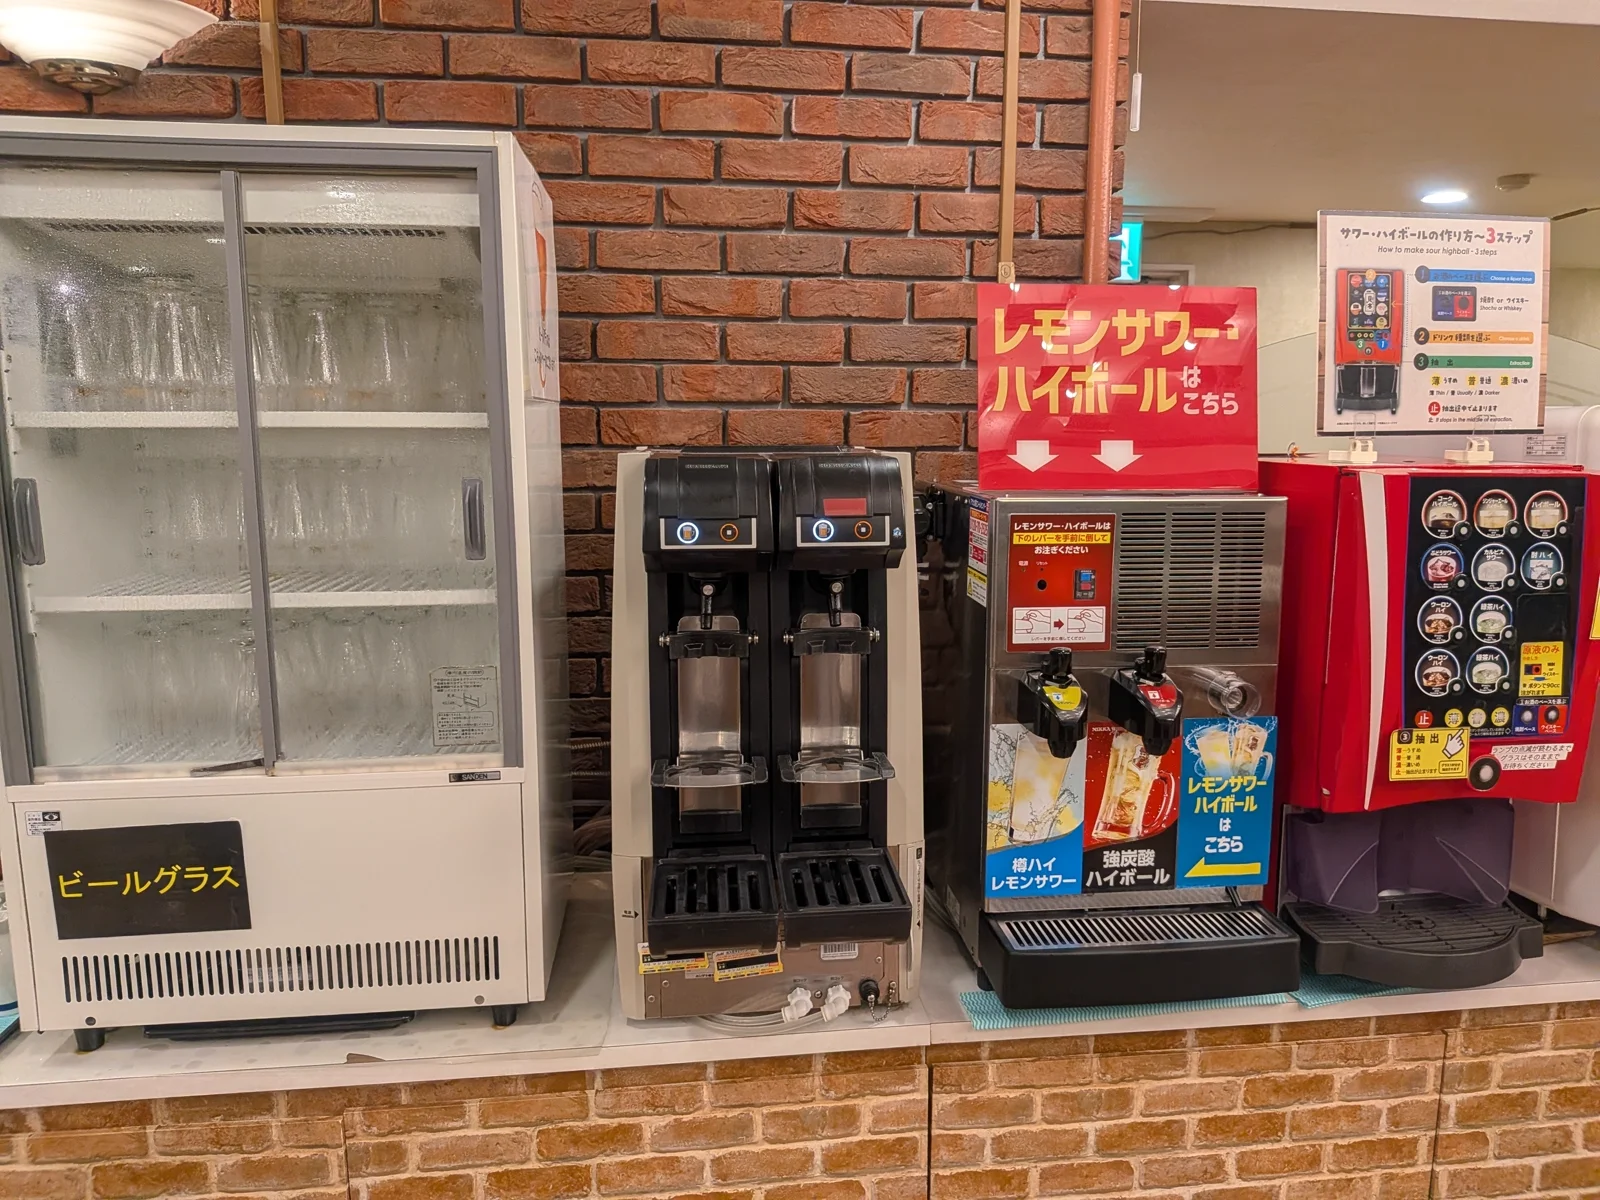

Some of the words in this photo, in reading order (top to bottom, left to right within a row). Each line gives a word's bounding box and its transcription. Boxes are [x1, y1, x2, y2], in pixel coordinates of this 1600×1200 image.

[1442, 247, 1470, 256] highball
[1480, 248, 1497, 256] steps
[1418, 331, 1425, 341] 2
[1419, 356, 1424, 367] 3
[1182, 366, 1201, 388] は
[993, 362, 1177, 414] ハイボール
[1183, 393, 1239, 415] こちら
[1430, 403, 1439, 413] 止
[1014, 522, 1111, 530] レモンサワー・ハイボールは
[1015, 534, 1108, 543] 下のレバーを手前に倒して
[1034, 546, 1089, 554] お注ぎください
[1417, 711, 1430, 725] 止
[1188, 776, 1267, 794] レモンサワー
[1194, 795, 1257, 814] ハイボール
[1219, 818, 1231, 832] は
[1204, 836, 1244, 853] こちら
[1012, 857, 1057, 873] 樽ハイ
[1102, 849, 1155, 868] 強炭酸
[58, 864, 240, 899] ビールグラス
[991, 876, 1077, 891] レモンサワー
[1086, 868, 1170, 888] ハイボール
